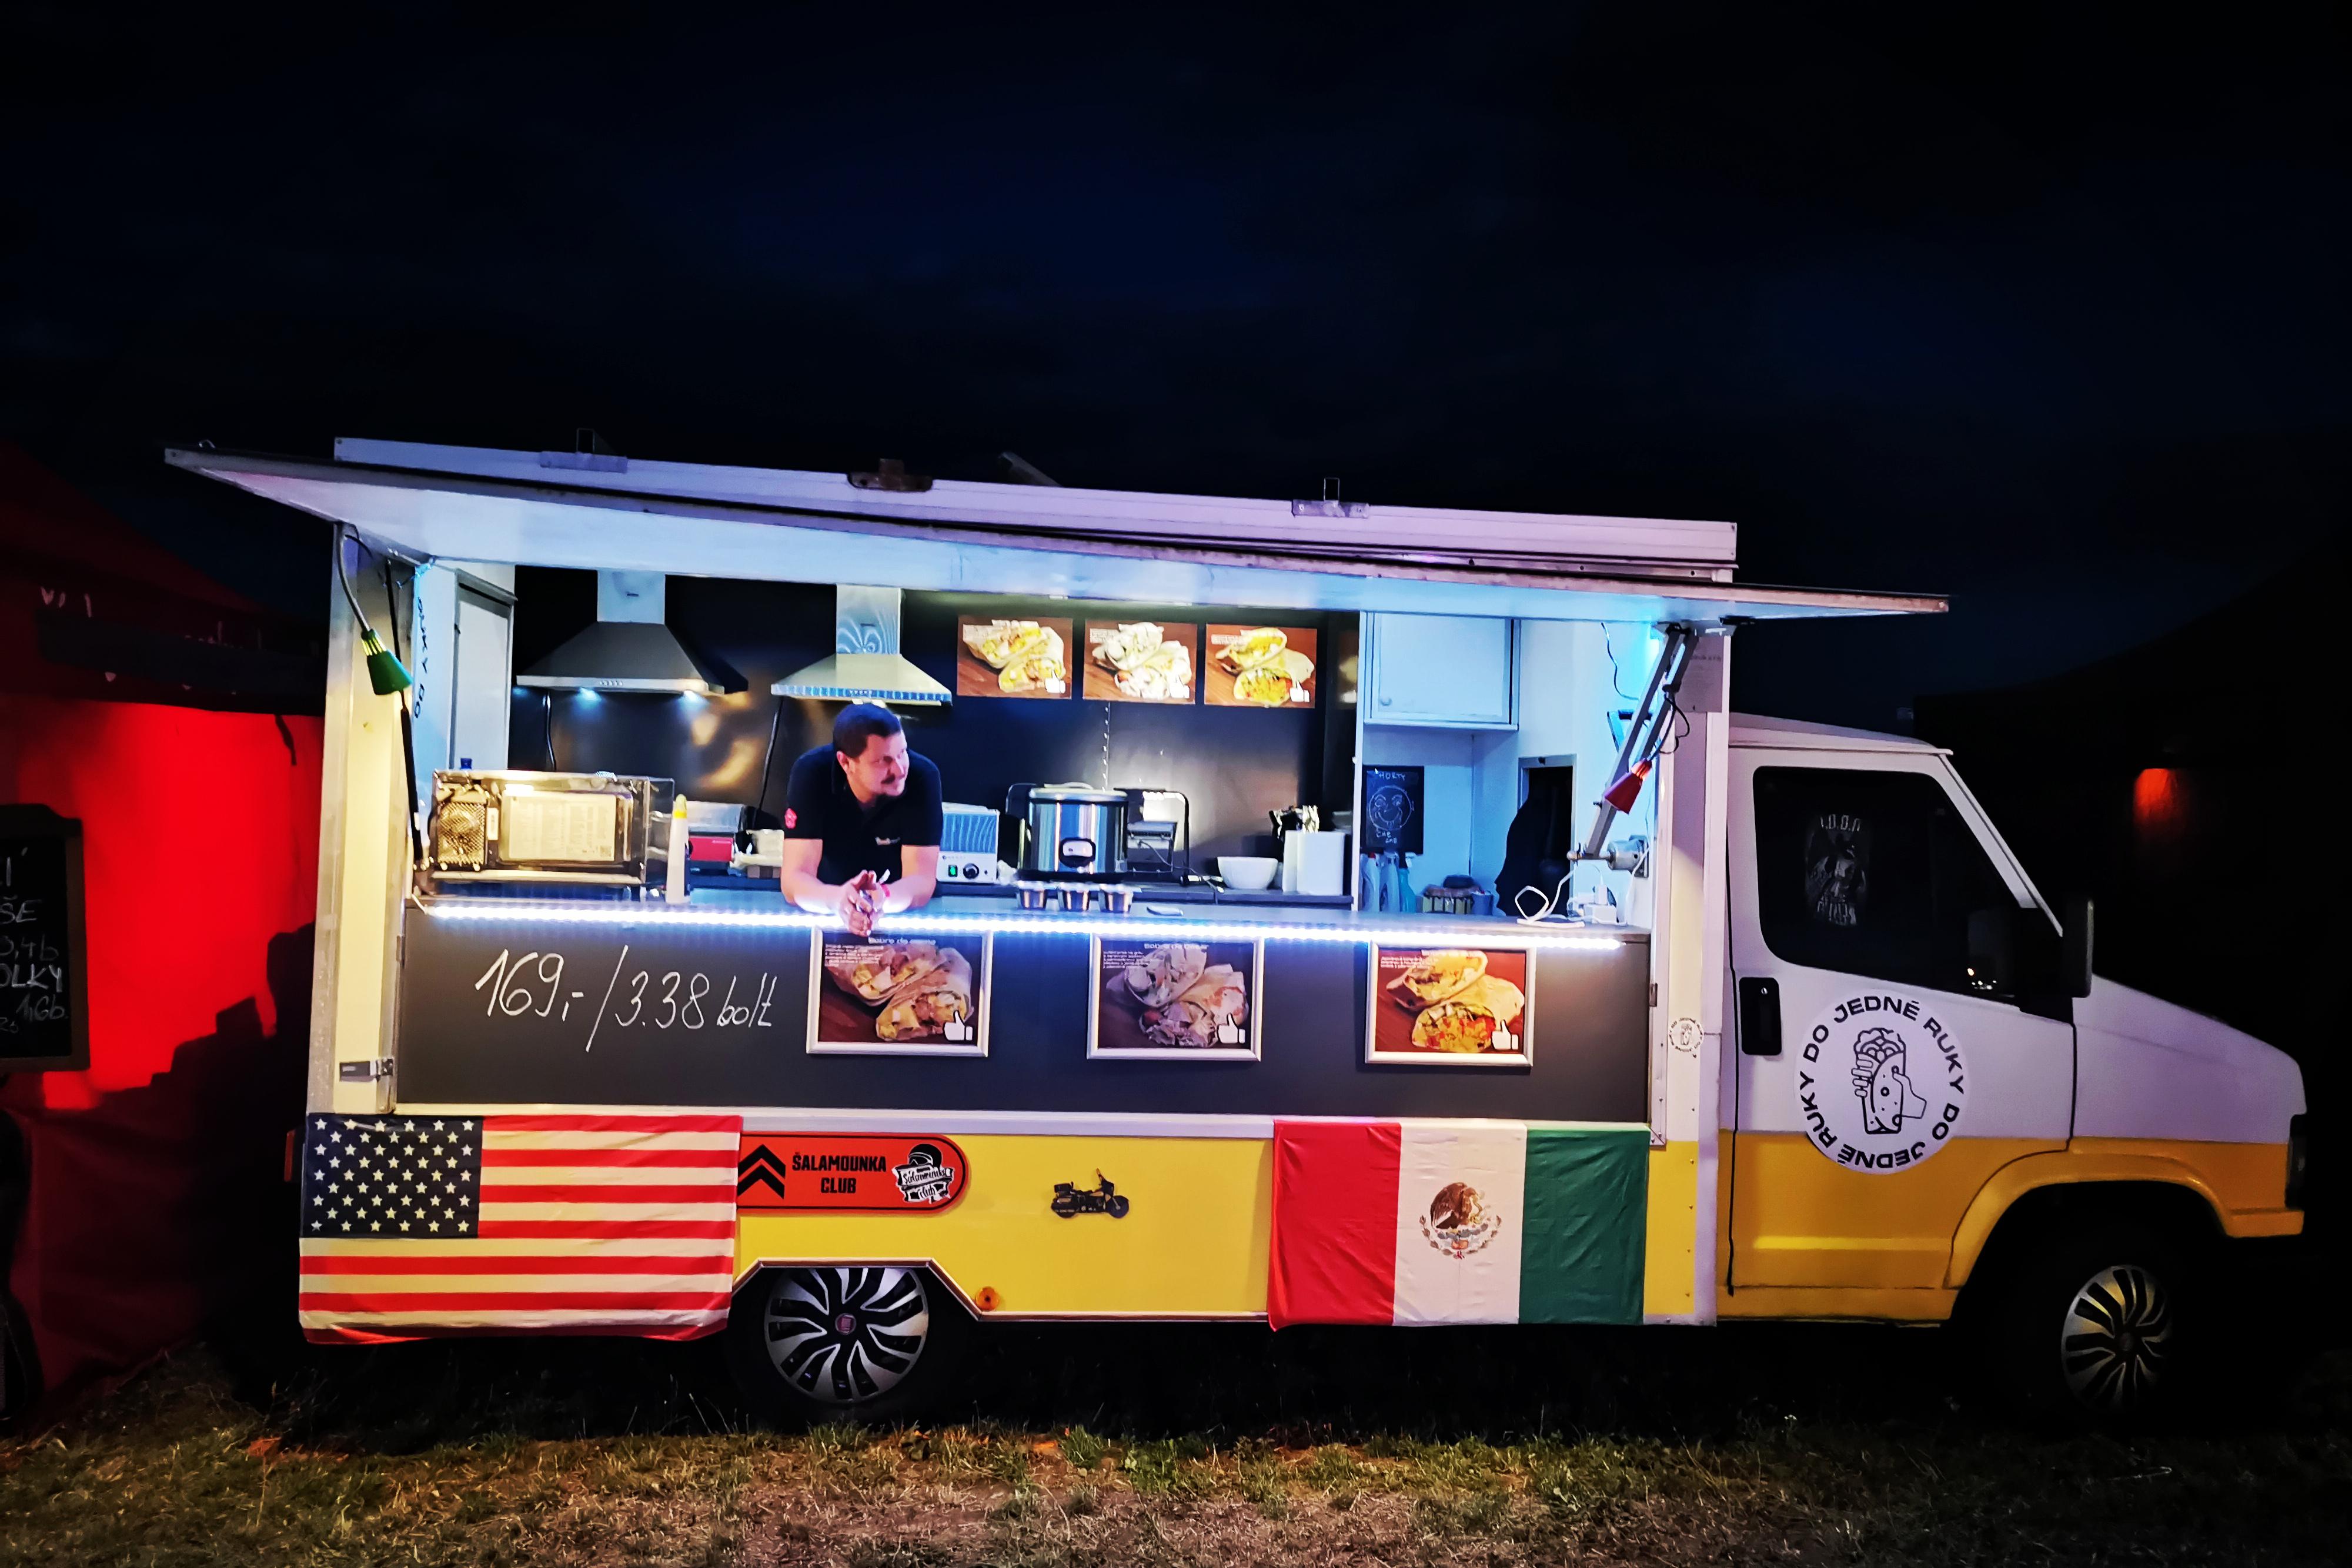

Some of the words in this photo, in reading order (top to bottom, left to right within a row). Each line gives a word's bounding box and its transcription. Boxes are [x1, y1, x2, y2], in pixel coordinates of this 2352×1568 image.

[1803, 1024, 1829, 1063] DO
[1923, 1017, 1965, 1094] RUKY
[1799, 1071, 1838, 1148] RUKY
[1932, 1103, 1960, 1141] DO
[792, 1151, 887, 1172] ŠALAMOUNKA
[820, 1177, 857, 1194] CLUB
